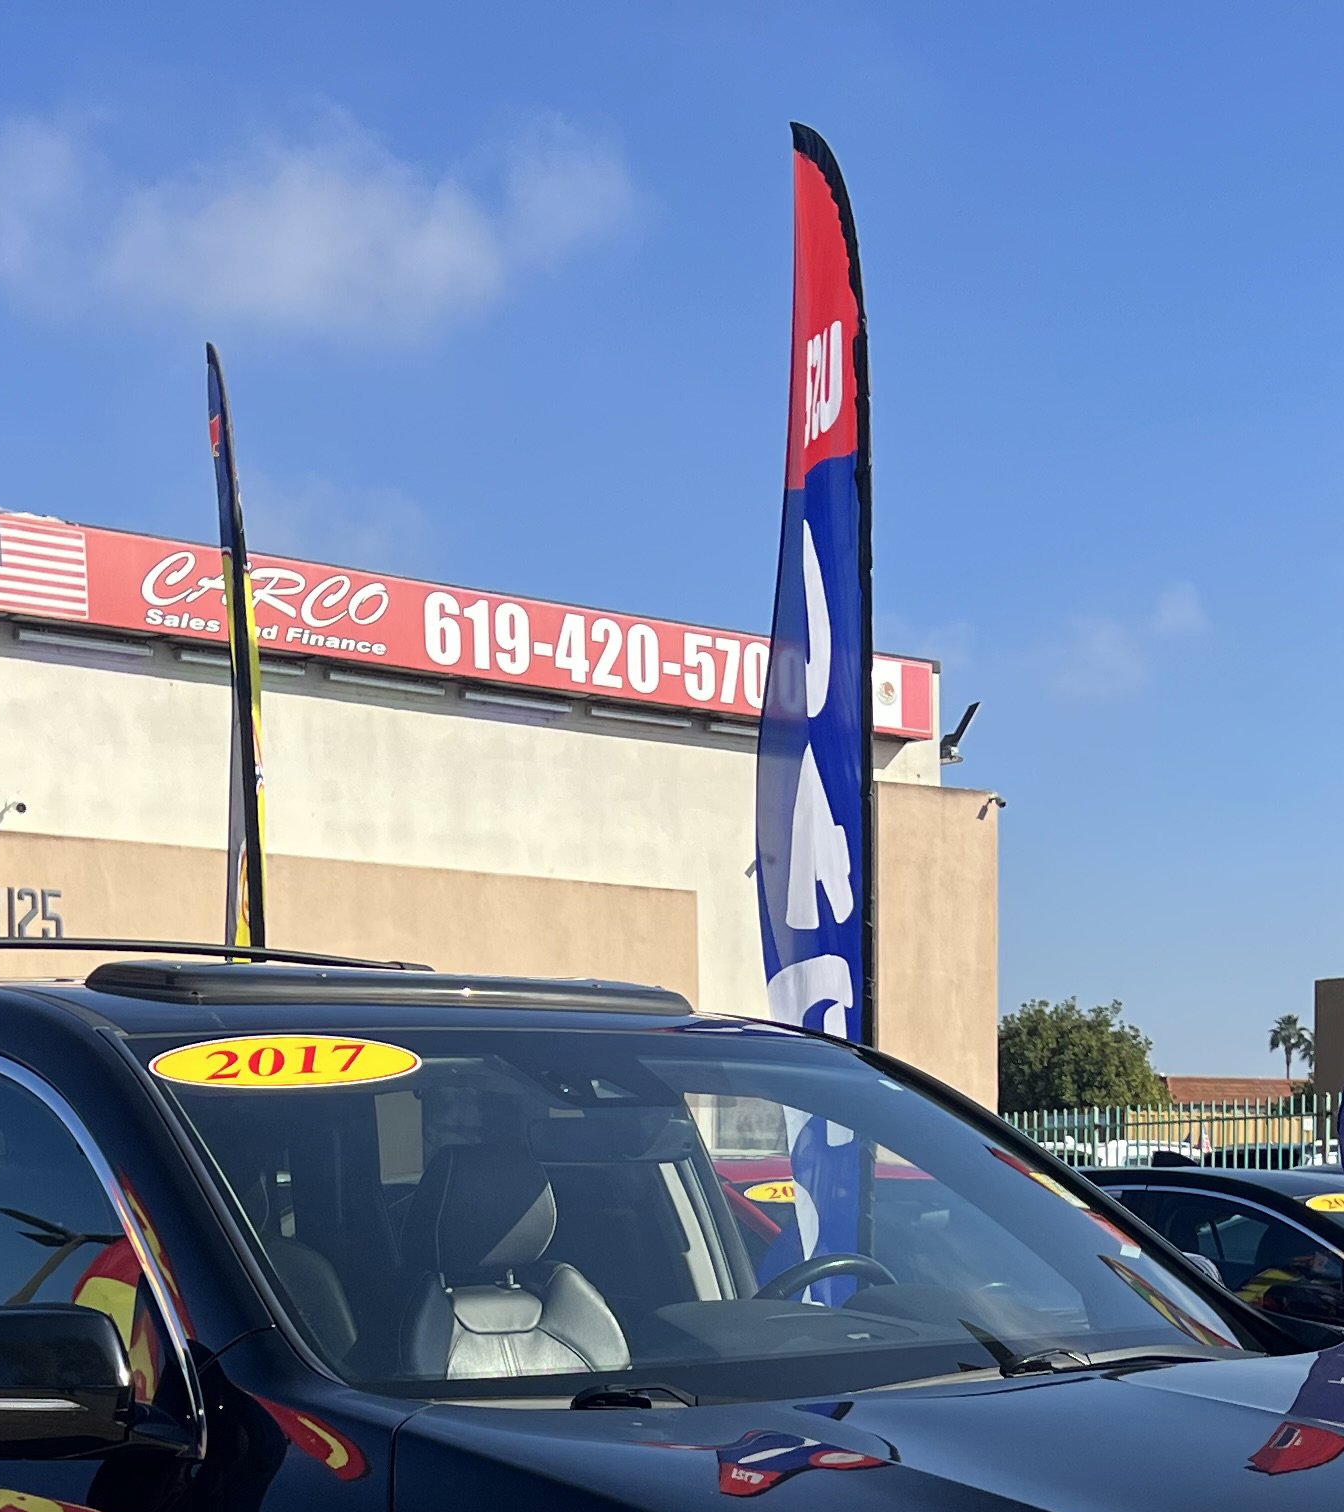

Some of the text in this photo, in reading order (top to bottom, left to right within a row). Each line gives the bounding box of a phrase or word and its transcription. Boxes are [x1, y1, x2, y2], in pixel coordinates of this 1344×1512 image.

[145, 608, 220, 633] Sales
[285, 627, 387, 655] Finance
[205, 1044, 365, 1081] 2017
[768, 1186, 796, 1200] 20
